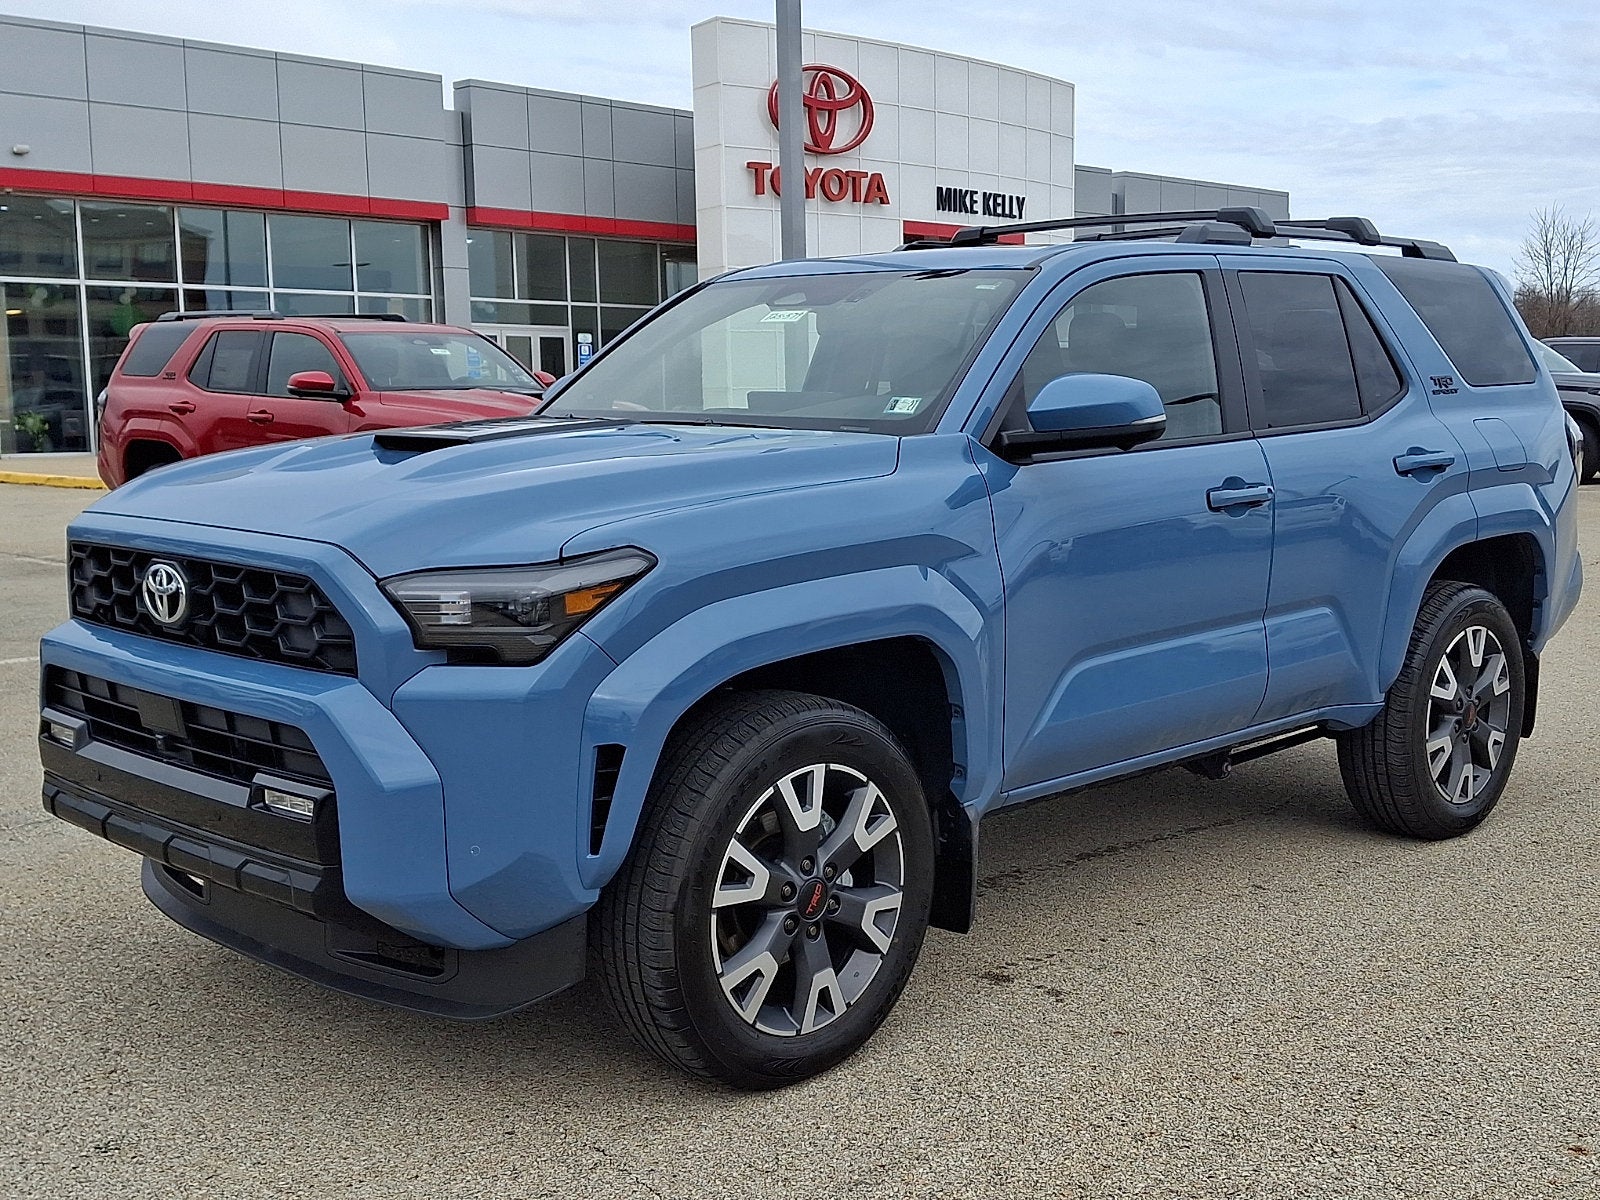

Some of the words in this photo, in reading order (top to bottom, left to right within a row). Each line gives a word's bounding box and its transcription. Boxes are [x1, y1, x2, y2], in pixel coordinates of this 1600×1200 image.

[936, 186, 979, 215] MIKE
[982, 191, 1026, 220] KELLY
[805, 883, 823, 915] TRD
